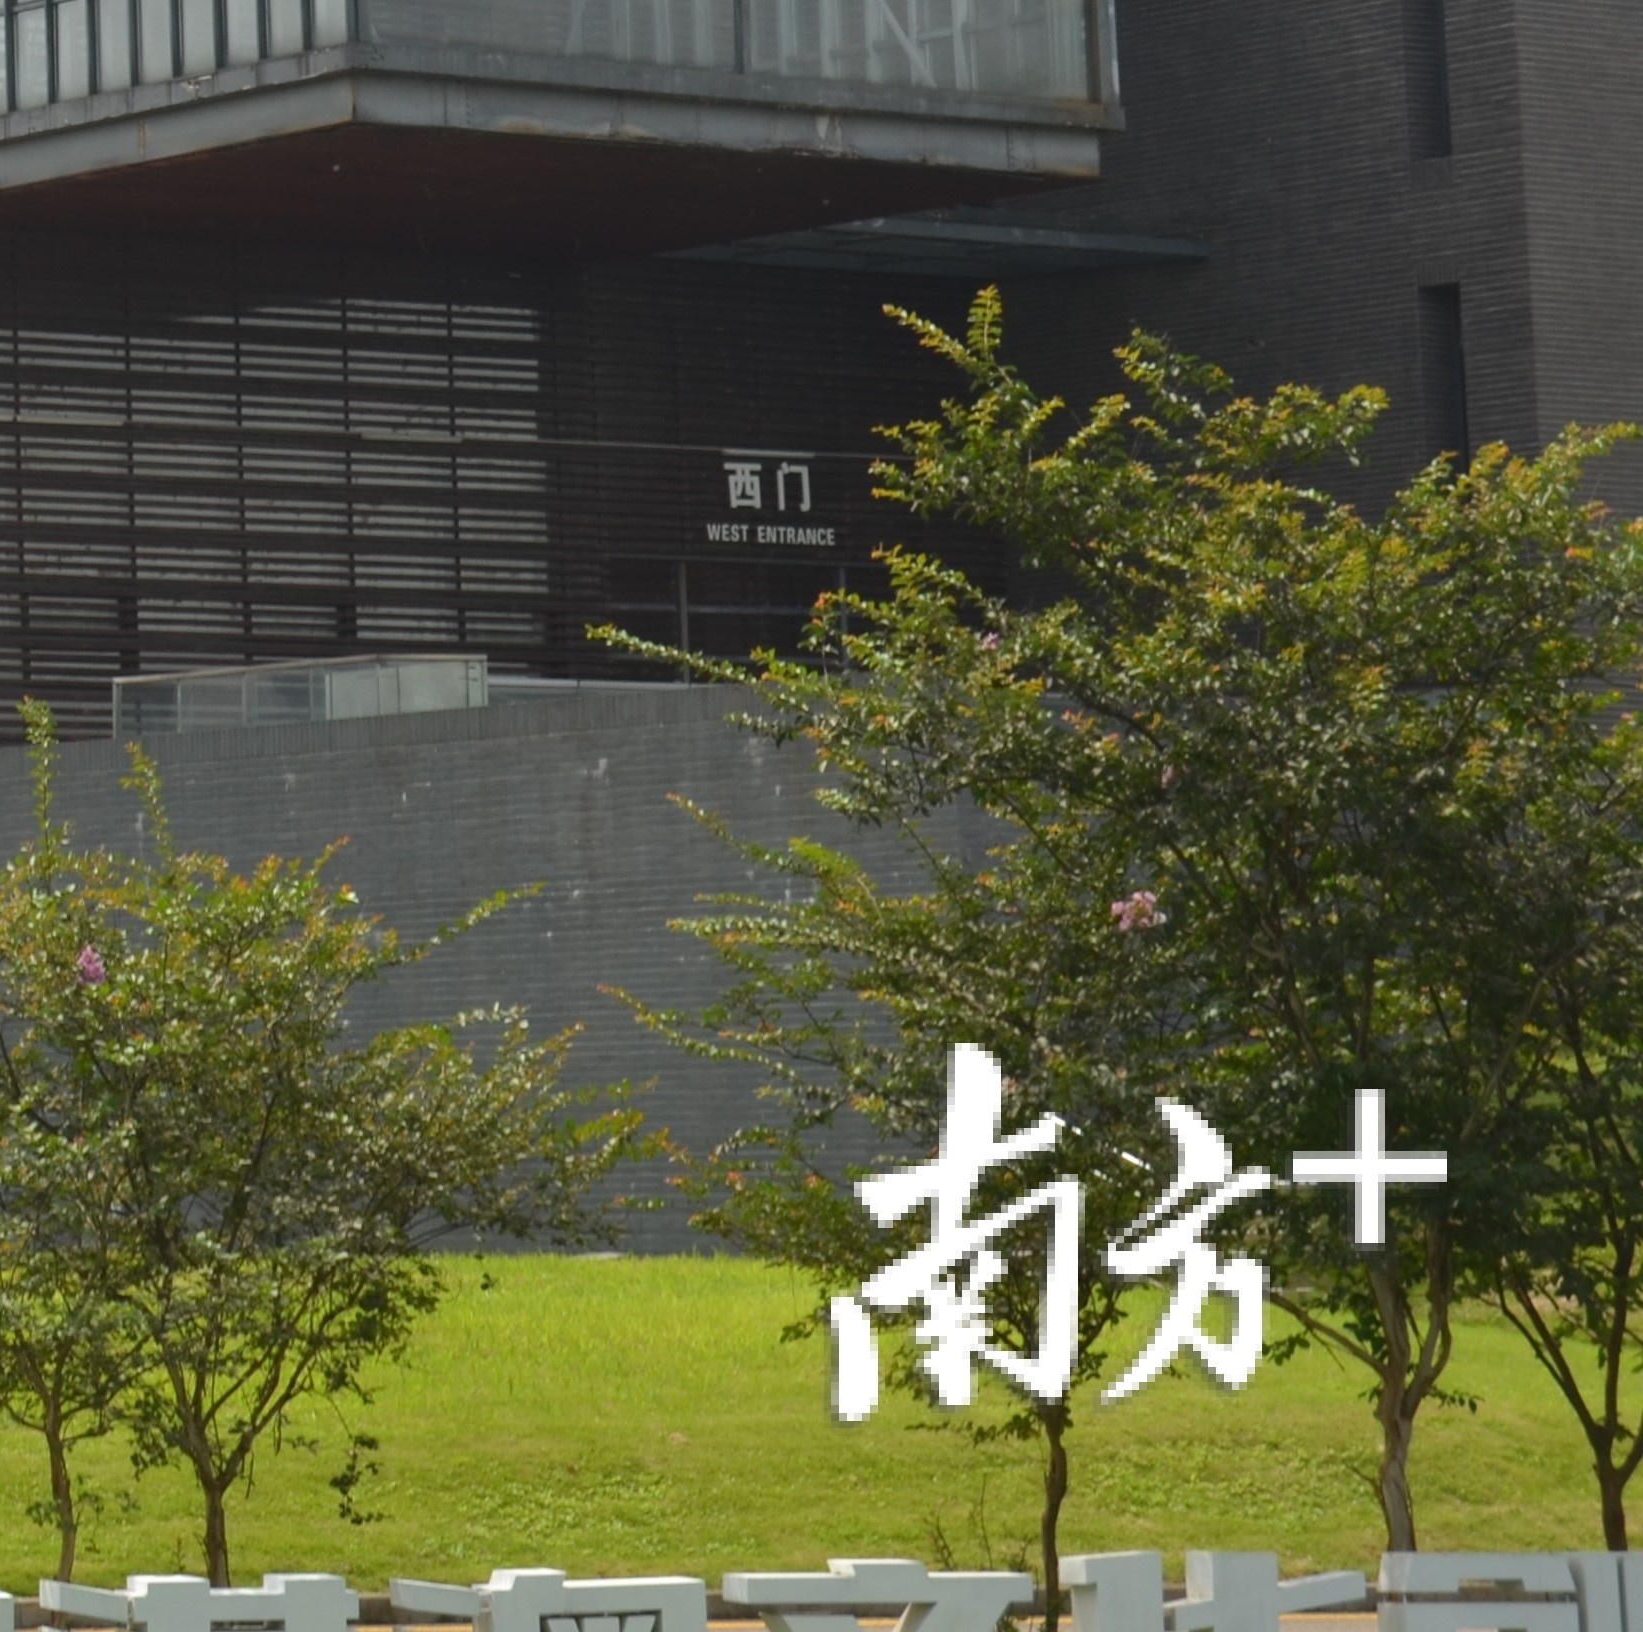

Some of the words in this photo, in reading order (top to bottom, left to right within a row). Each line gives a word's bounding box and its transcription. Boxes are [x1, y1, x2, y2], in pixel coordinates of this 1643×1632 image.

[723, 461, 812, 512] 西门
[707, 523, 749, 542] WEST
[757, 525, 836, 547] ENTRANCE
